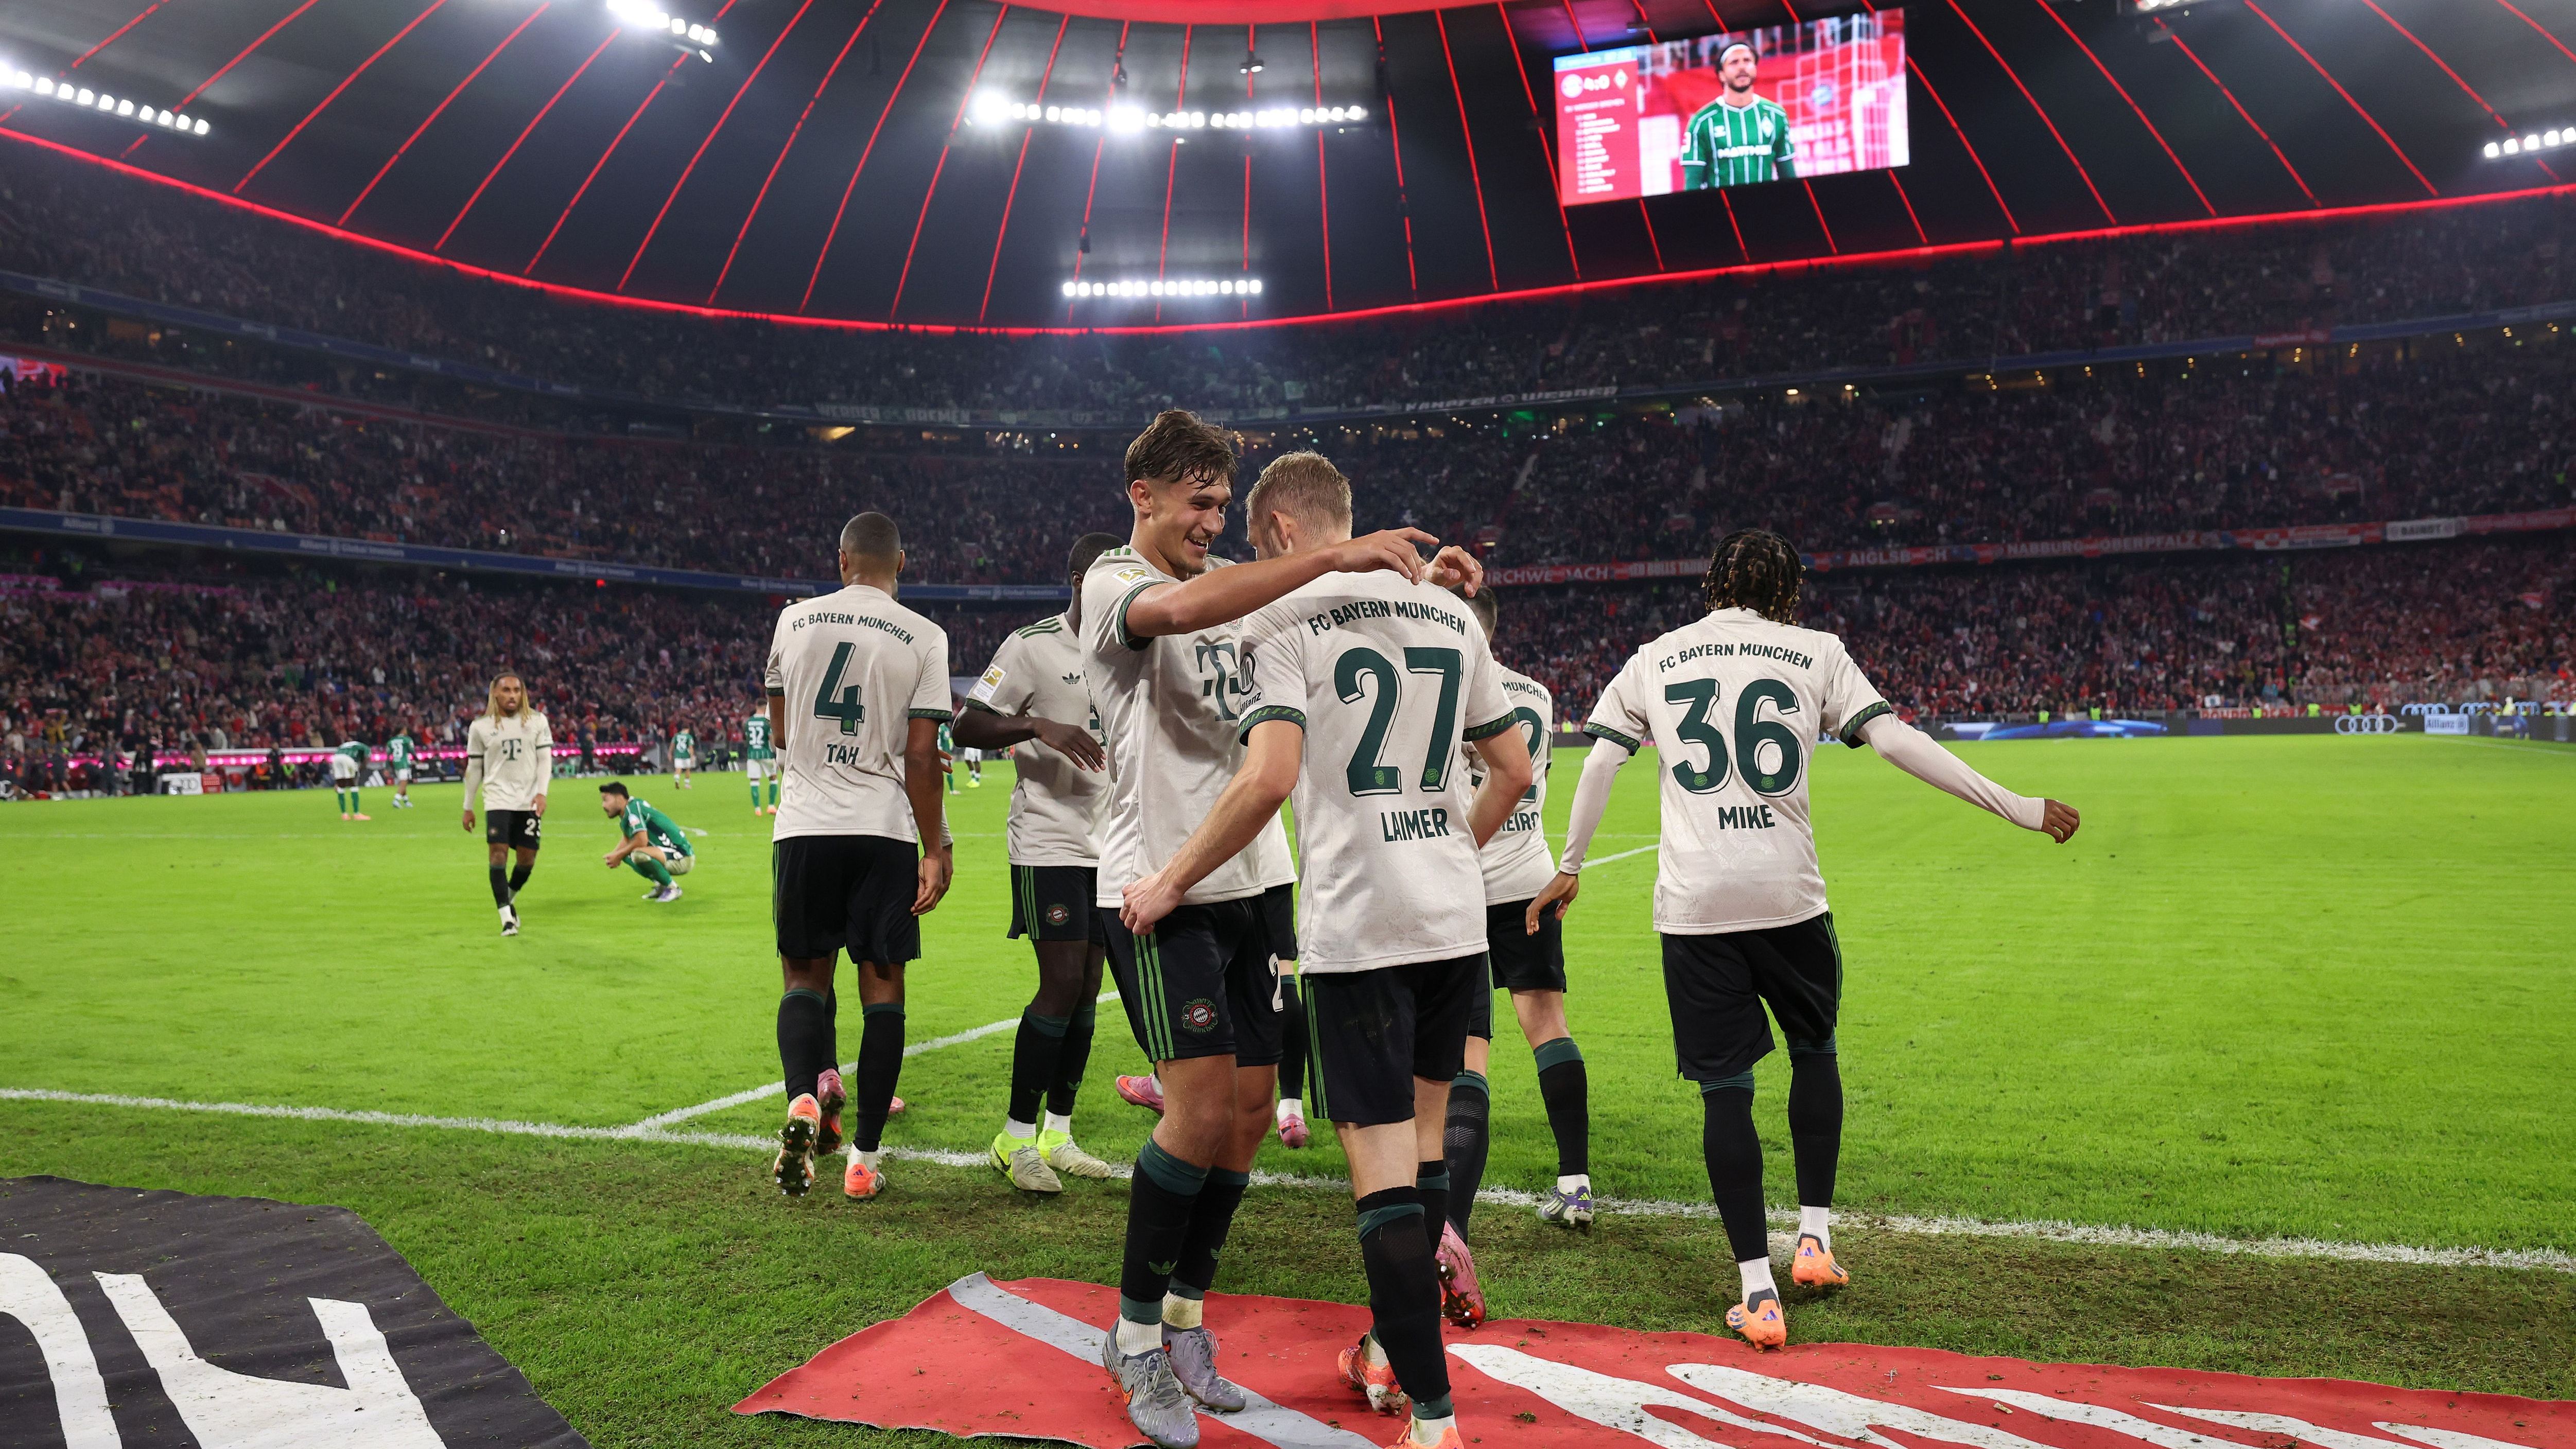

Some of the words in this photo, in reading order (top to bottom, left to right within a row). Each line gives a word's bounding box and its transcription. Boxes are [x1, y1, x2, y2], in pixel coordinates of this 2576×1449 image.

[792, 618, 805, 631] FC
[809, 613, 854, 625] BAYERN
[858, 615, 914, 645] MÜNCHEN
[1308, 614, 1331, 636] FC
[1330, 601, 1391, 626] BAYERN
[1395, 601, 1466, 636] MÜNCHEN
[1659, 656, 1676, 672] FC
[1680, 644, 1734, 664] BAYERN
[1739, 643, 1813, 670] MÜNCHEN
[814, 641, 865, 736] 4
[1502, 682, 1548, 704] MÜNCHEN
[749, 726, 764, 745] 32
[1334, 647, 1463, 798] 27
[1665, 678, 1803, 797] 36
[2426, 718, 2455, 729] Allianz
[827, 744, 860, 765] TAH
[1381, 808, 1450, 842] LAIMER
[1718, 805, 1775, 829] MIKE
